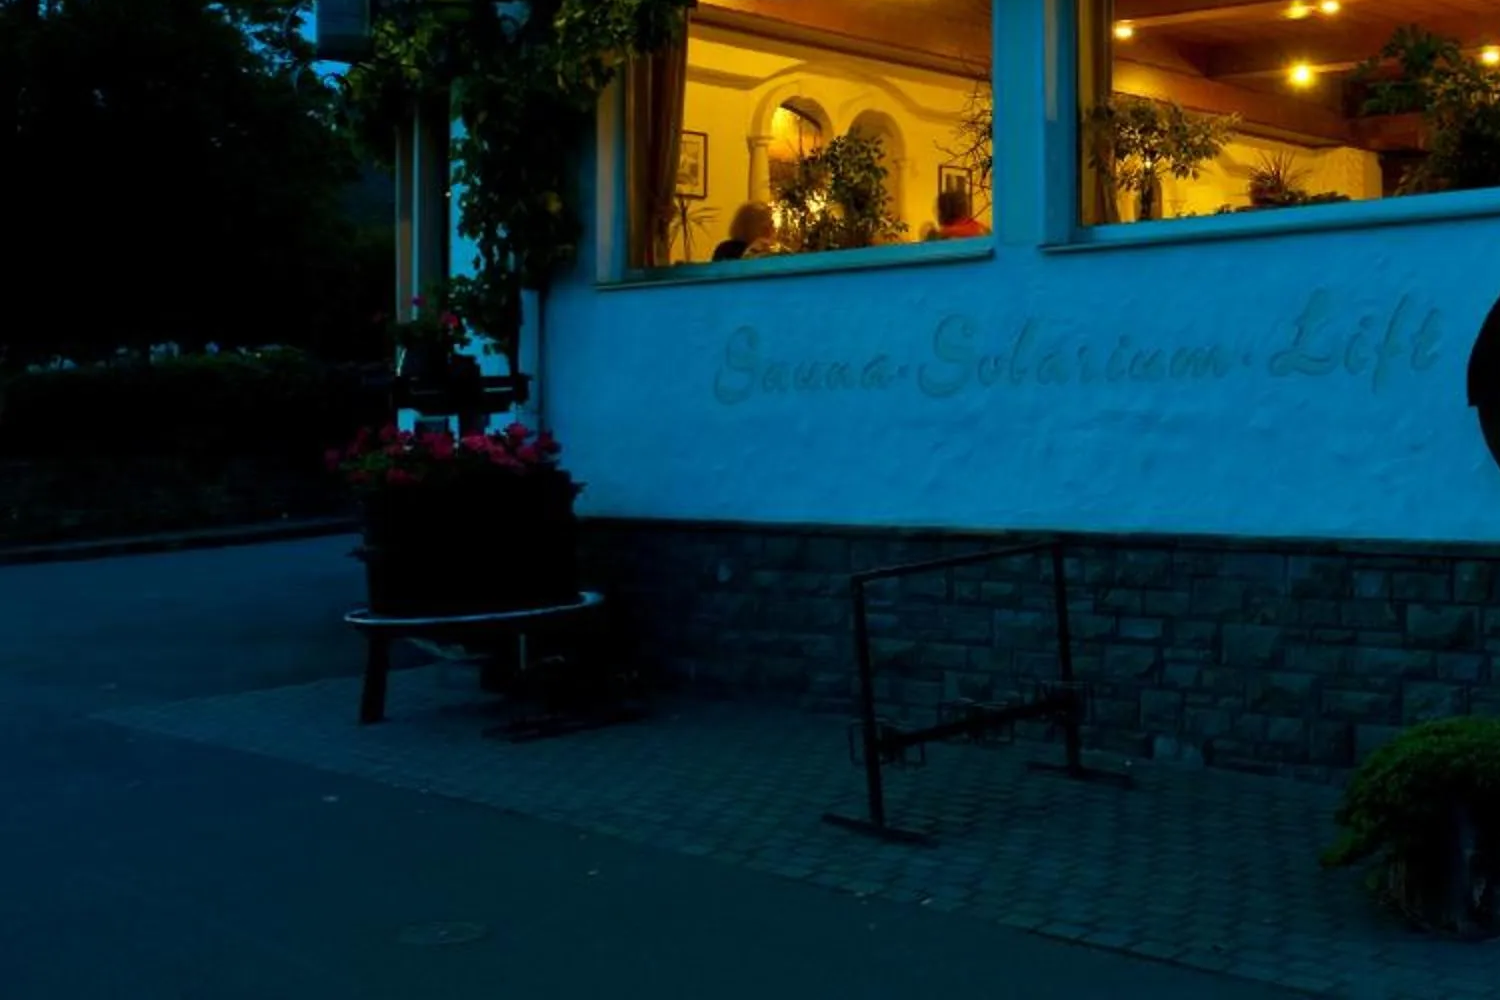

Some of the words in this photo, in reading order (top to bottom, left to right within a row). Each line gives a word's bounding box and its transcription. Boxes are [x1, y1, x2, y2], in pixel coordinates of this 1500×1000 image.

[712, 325, 896, 406] Sauna
[916, 313, 1228, 399] Solarium
[1267, 287, 1443, 396] Lift
